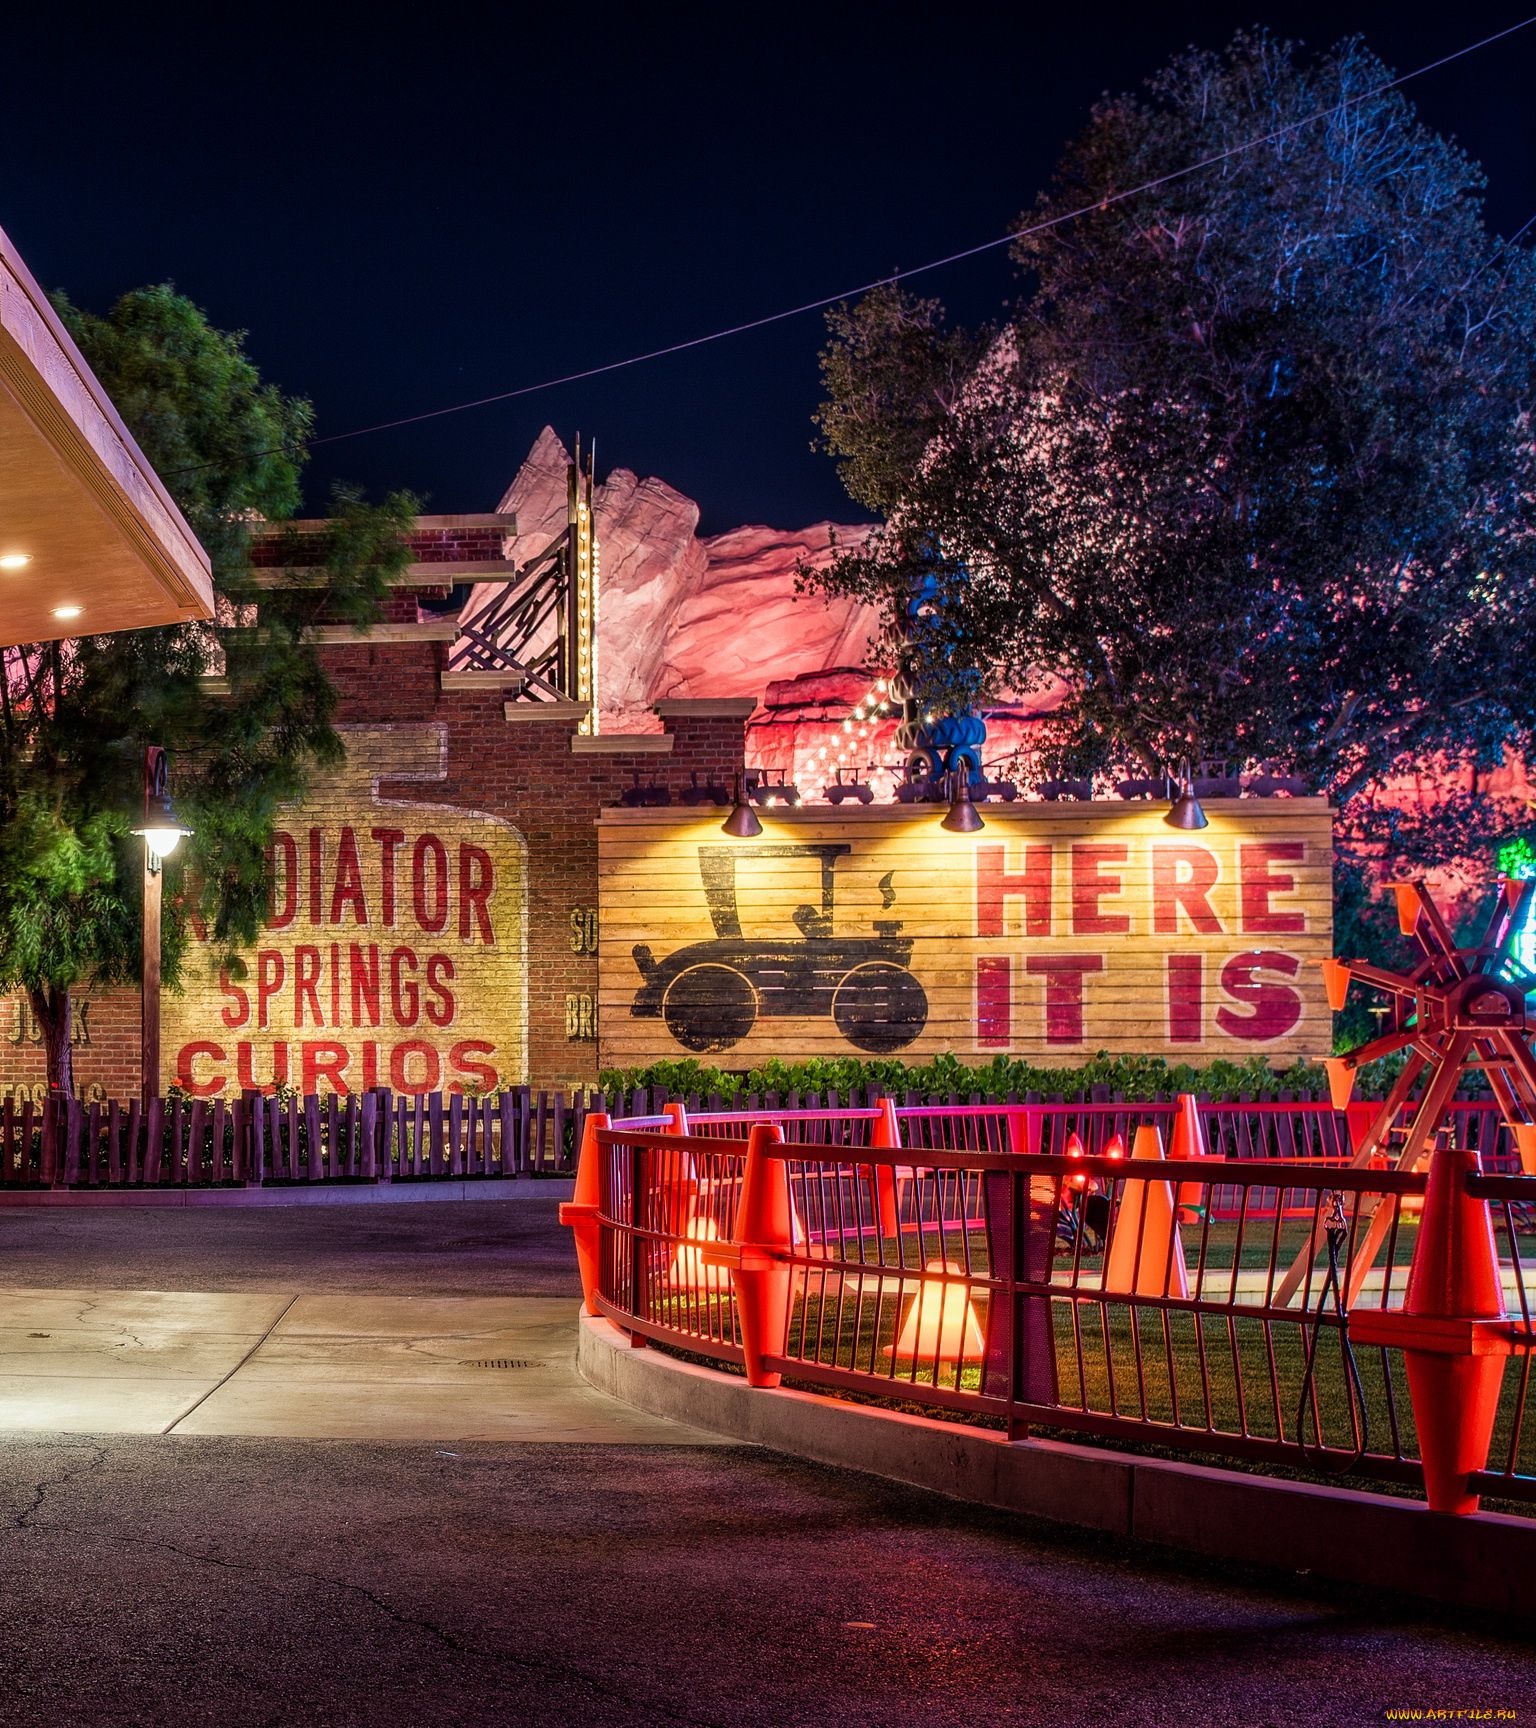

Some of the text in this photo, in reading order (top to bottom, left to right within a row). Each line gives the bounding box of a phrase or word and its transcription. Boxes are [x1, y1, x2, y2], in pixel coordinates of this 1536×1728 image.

[175, 826, 496, 946] DIATOR
[974, 840, 1308, 938] HERE
[7, 998, 88, 1042] JUK
[219, 943, 457, 1029] SPRINGS
[975, 950, 1305, 1047] IT IS
[176, 1039, 500, 1097] CURIOS
